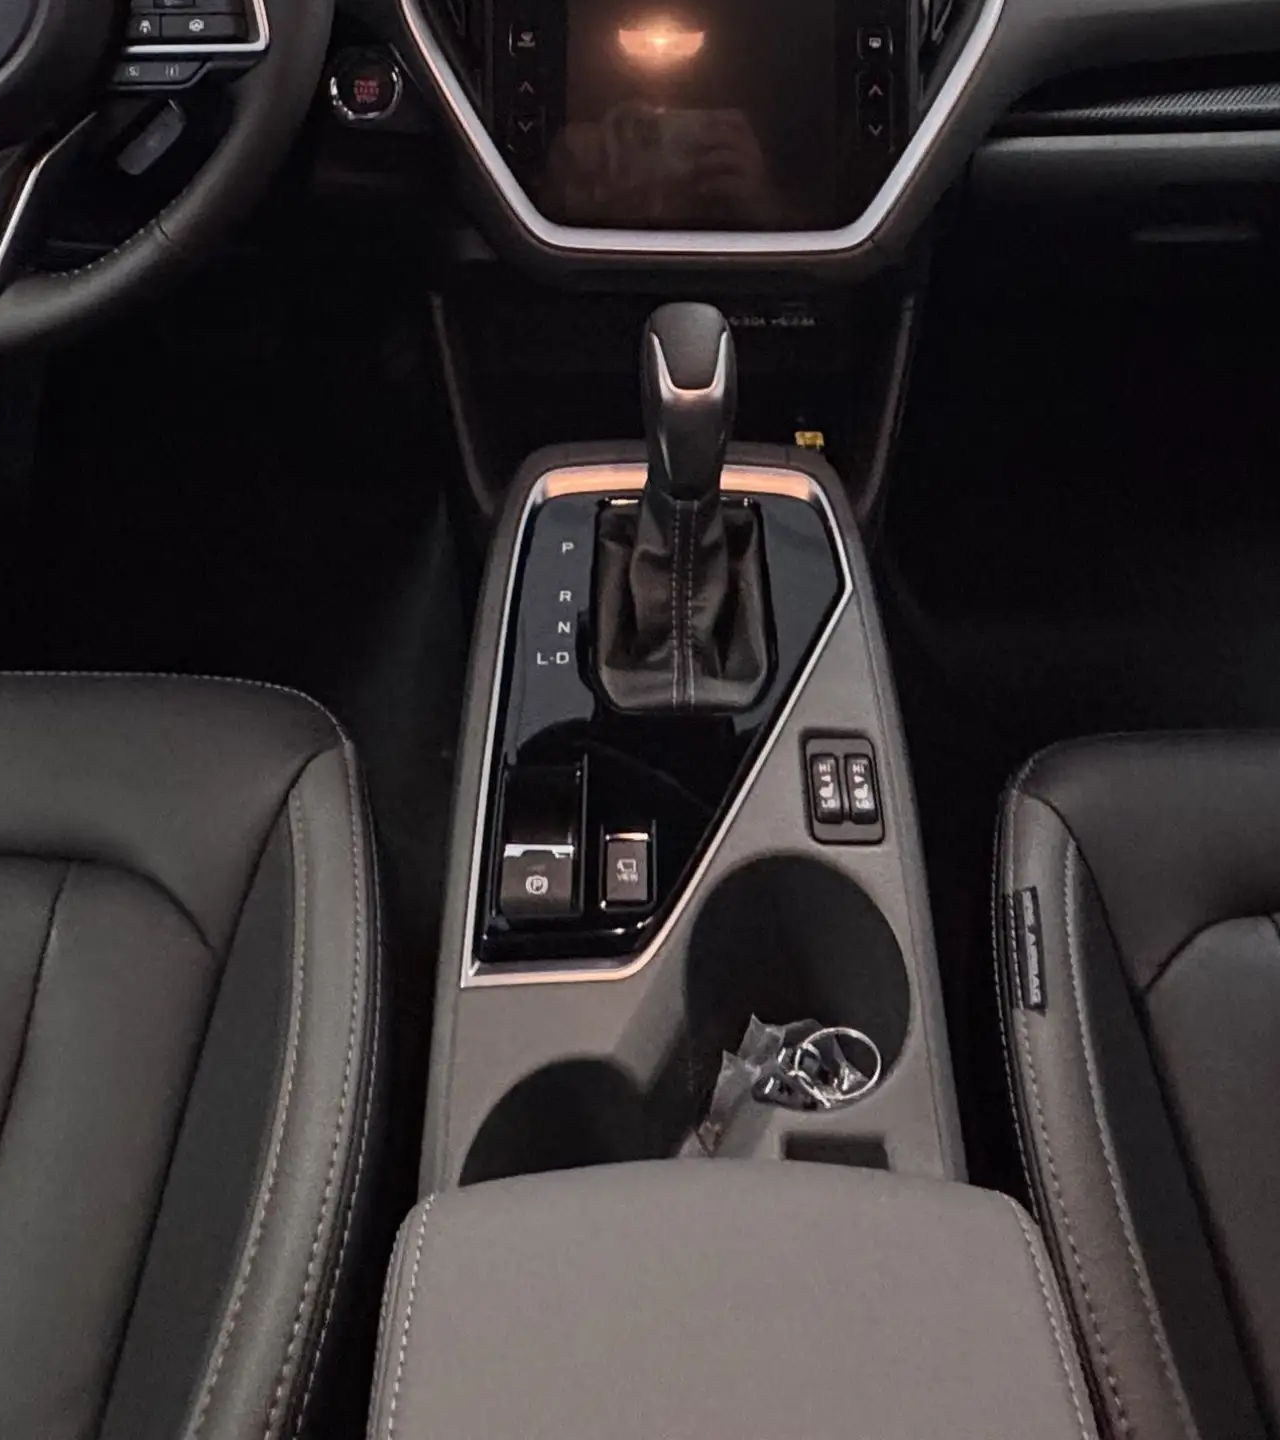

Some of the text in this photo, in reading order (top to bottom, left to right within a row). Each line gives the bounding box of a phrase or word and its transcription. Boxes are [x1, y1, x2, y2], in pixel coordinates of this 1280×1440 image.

[562, 542, 575, 554] P
[560, 590, 572, 602] R
[558, 621, 571, 634] N
